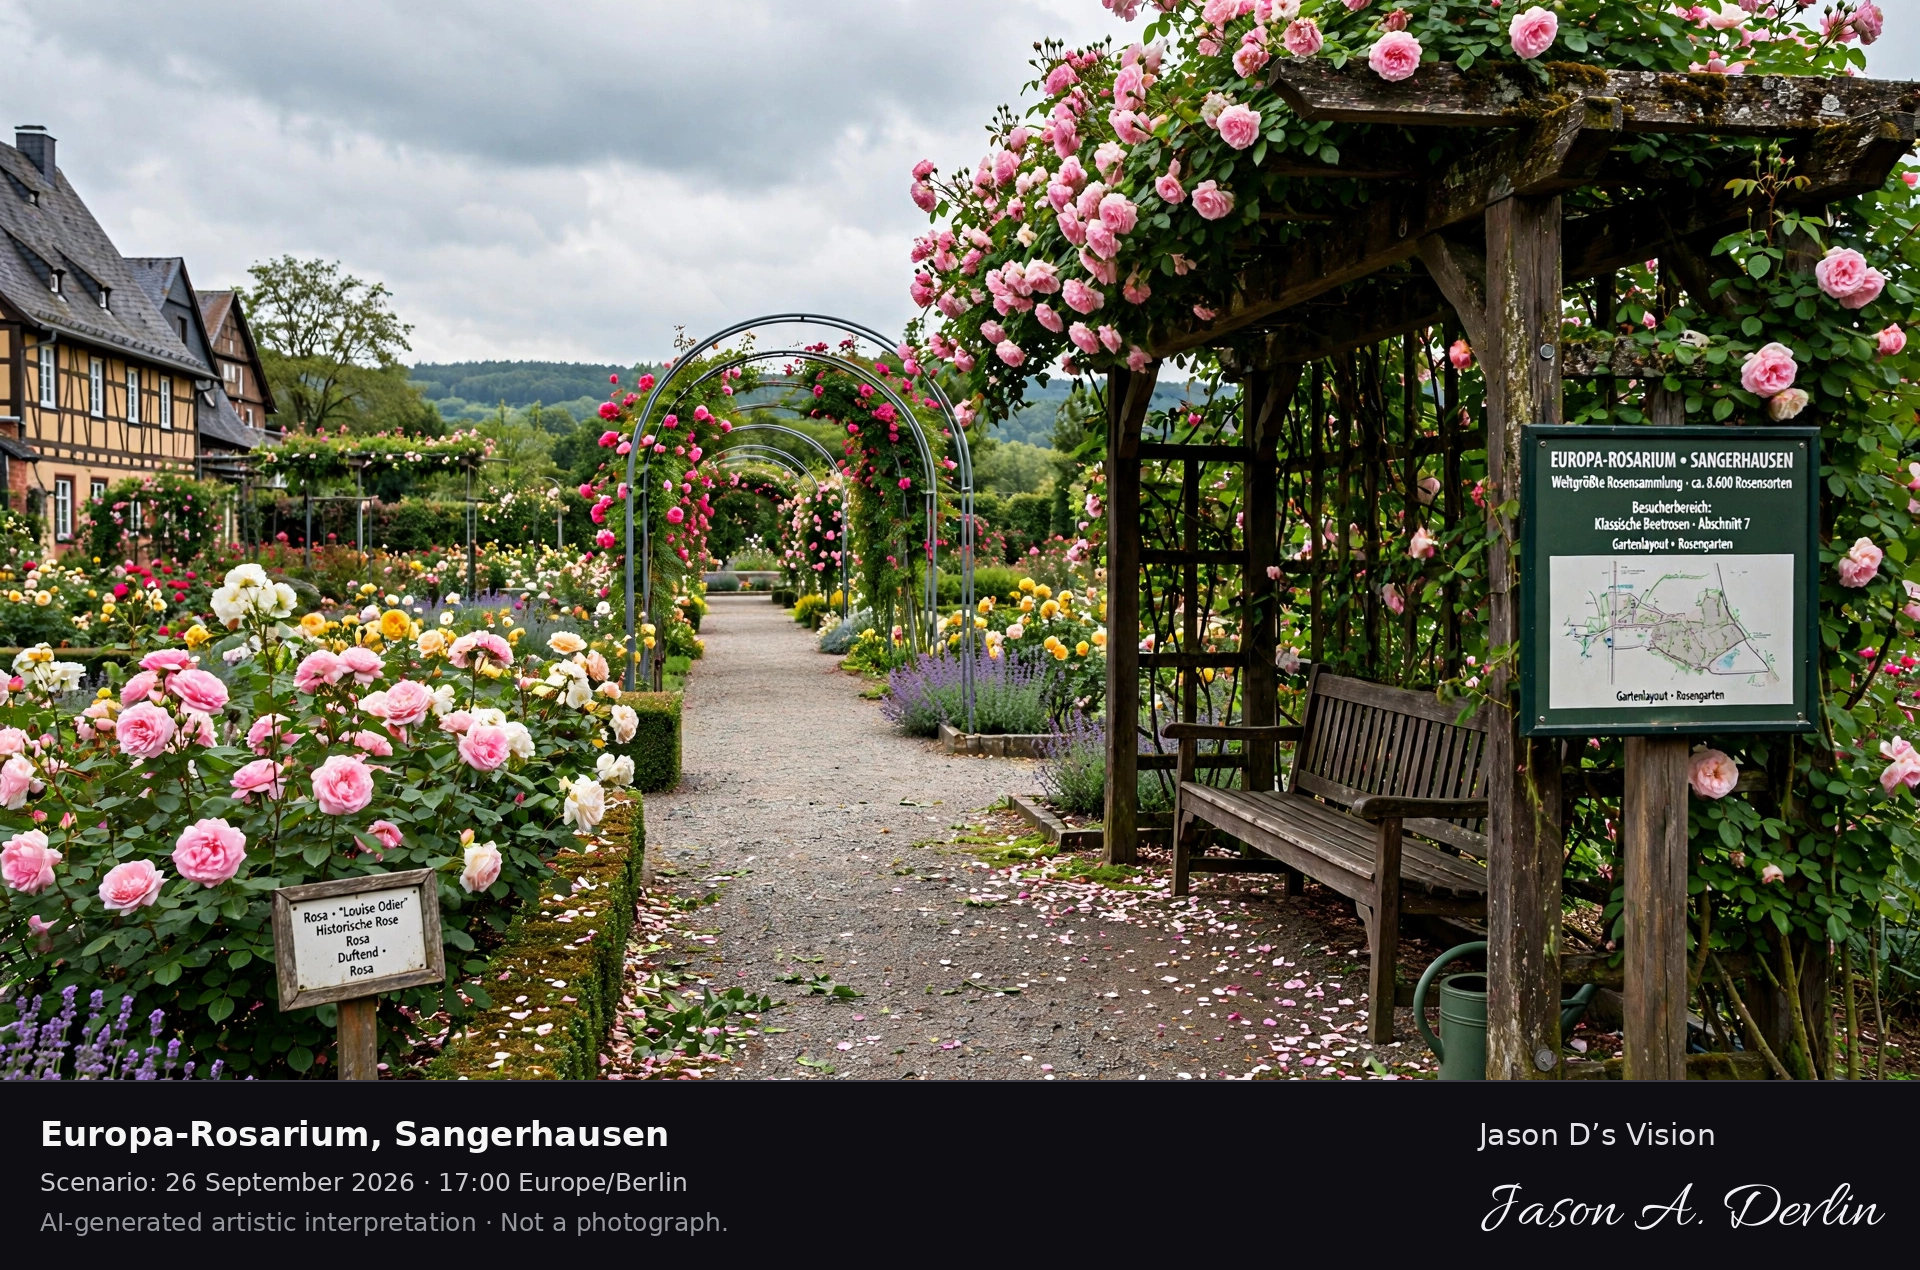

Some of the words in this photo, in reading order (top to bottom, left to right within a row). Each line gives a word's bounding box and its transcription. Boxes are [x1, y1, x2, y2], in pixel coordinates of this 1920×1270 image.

[1550, 451, 1677, 469] EUROPA-ROSARIUM
[1690, 451, 1794, 469] SANGERHAUSEN
[1607, 474, 1683, 493] Rosensammlung
[1691, 477, 1705, 489] ca.
[1707, 475, 1734, 489] 8.600
[1736, 475, 1793, 490] Rosensorten
[1632, 500, 1713, 514] Besucherbereich:
[1594, 516, 1642, 532] Klassische
[1643, 517, 1691, 531] Beetrosen
[1697, 515, 1743, 531] Abschnitt
[1743, 517, 1751, 531] 7
[1612, 536, 1670, 553] Gartenlayout
[1677, 537, 1734, 553] Rosengarten
[1616, 690, 1669, 706] Gartenlayout
[1676, 689, 1726, 705] Rosengarten
[303, 912, 328, 923] Rosa
[378, 897, 408, 912] Odier”
[316, 919, 373, 936] Historische
[375, 915, 399, 928] Rose
[346, 935, 370, 946] Rosa
[338, 946, 379, 963] Duftend
[349, 965, 374, 976] Rosa
